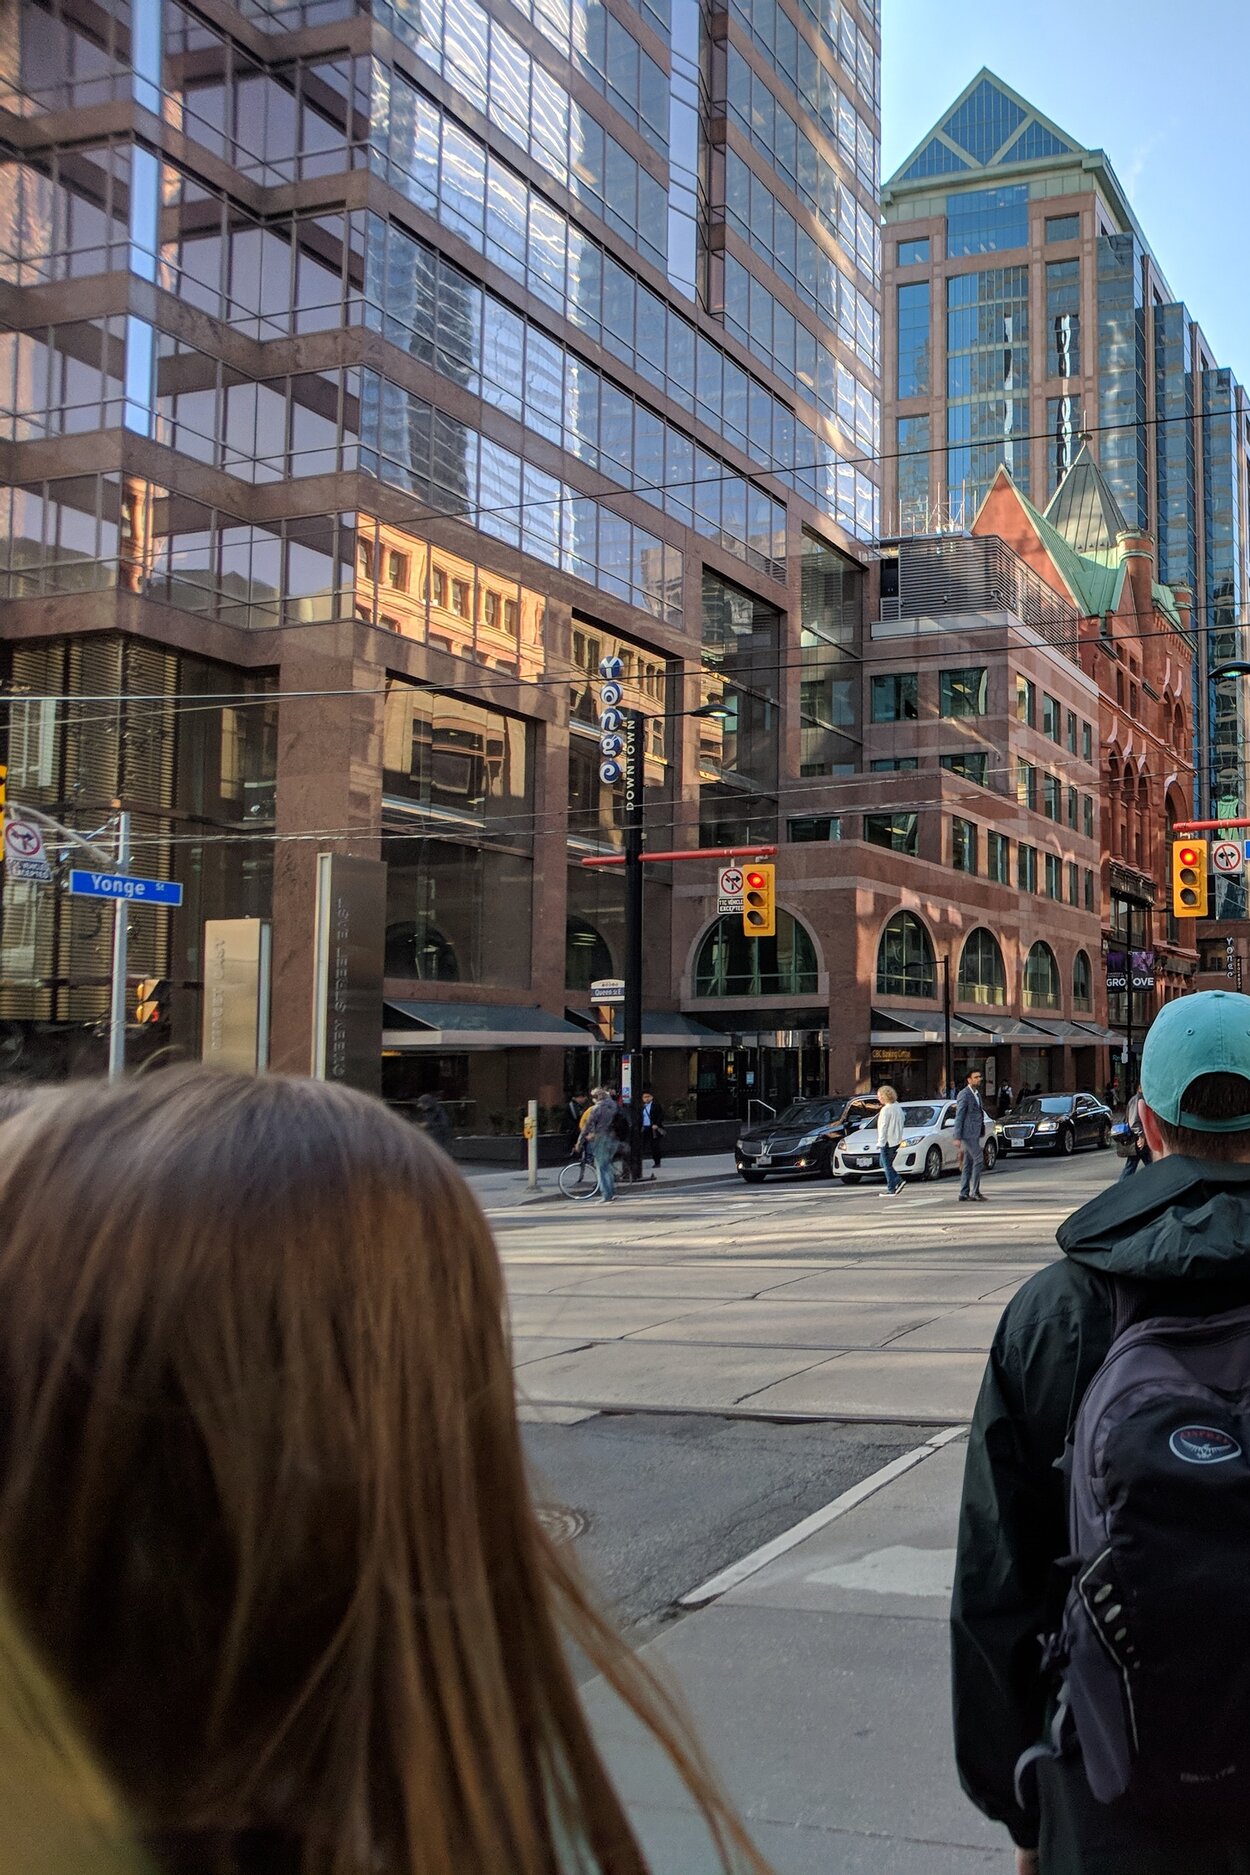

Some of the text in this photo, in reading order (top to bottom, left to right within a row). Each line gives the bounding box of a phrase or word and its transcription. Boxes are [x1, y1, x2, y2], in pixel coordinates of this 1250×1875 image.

[600, 656, 624, 784] Yonge
[626, 720, 636, 811] DOWNTOWN
[91, 874, 165, 897] Yonge St
